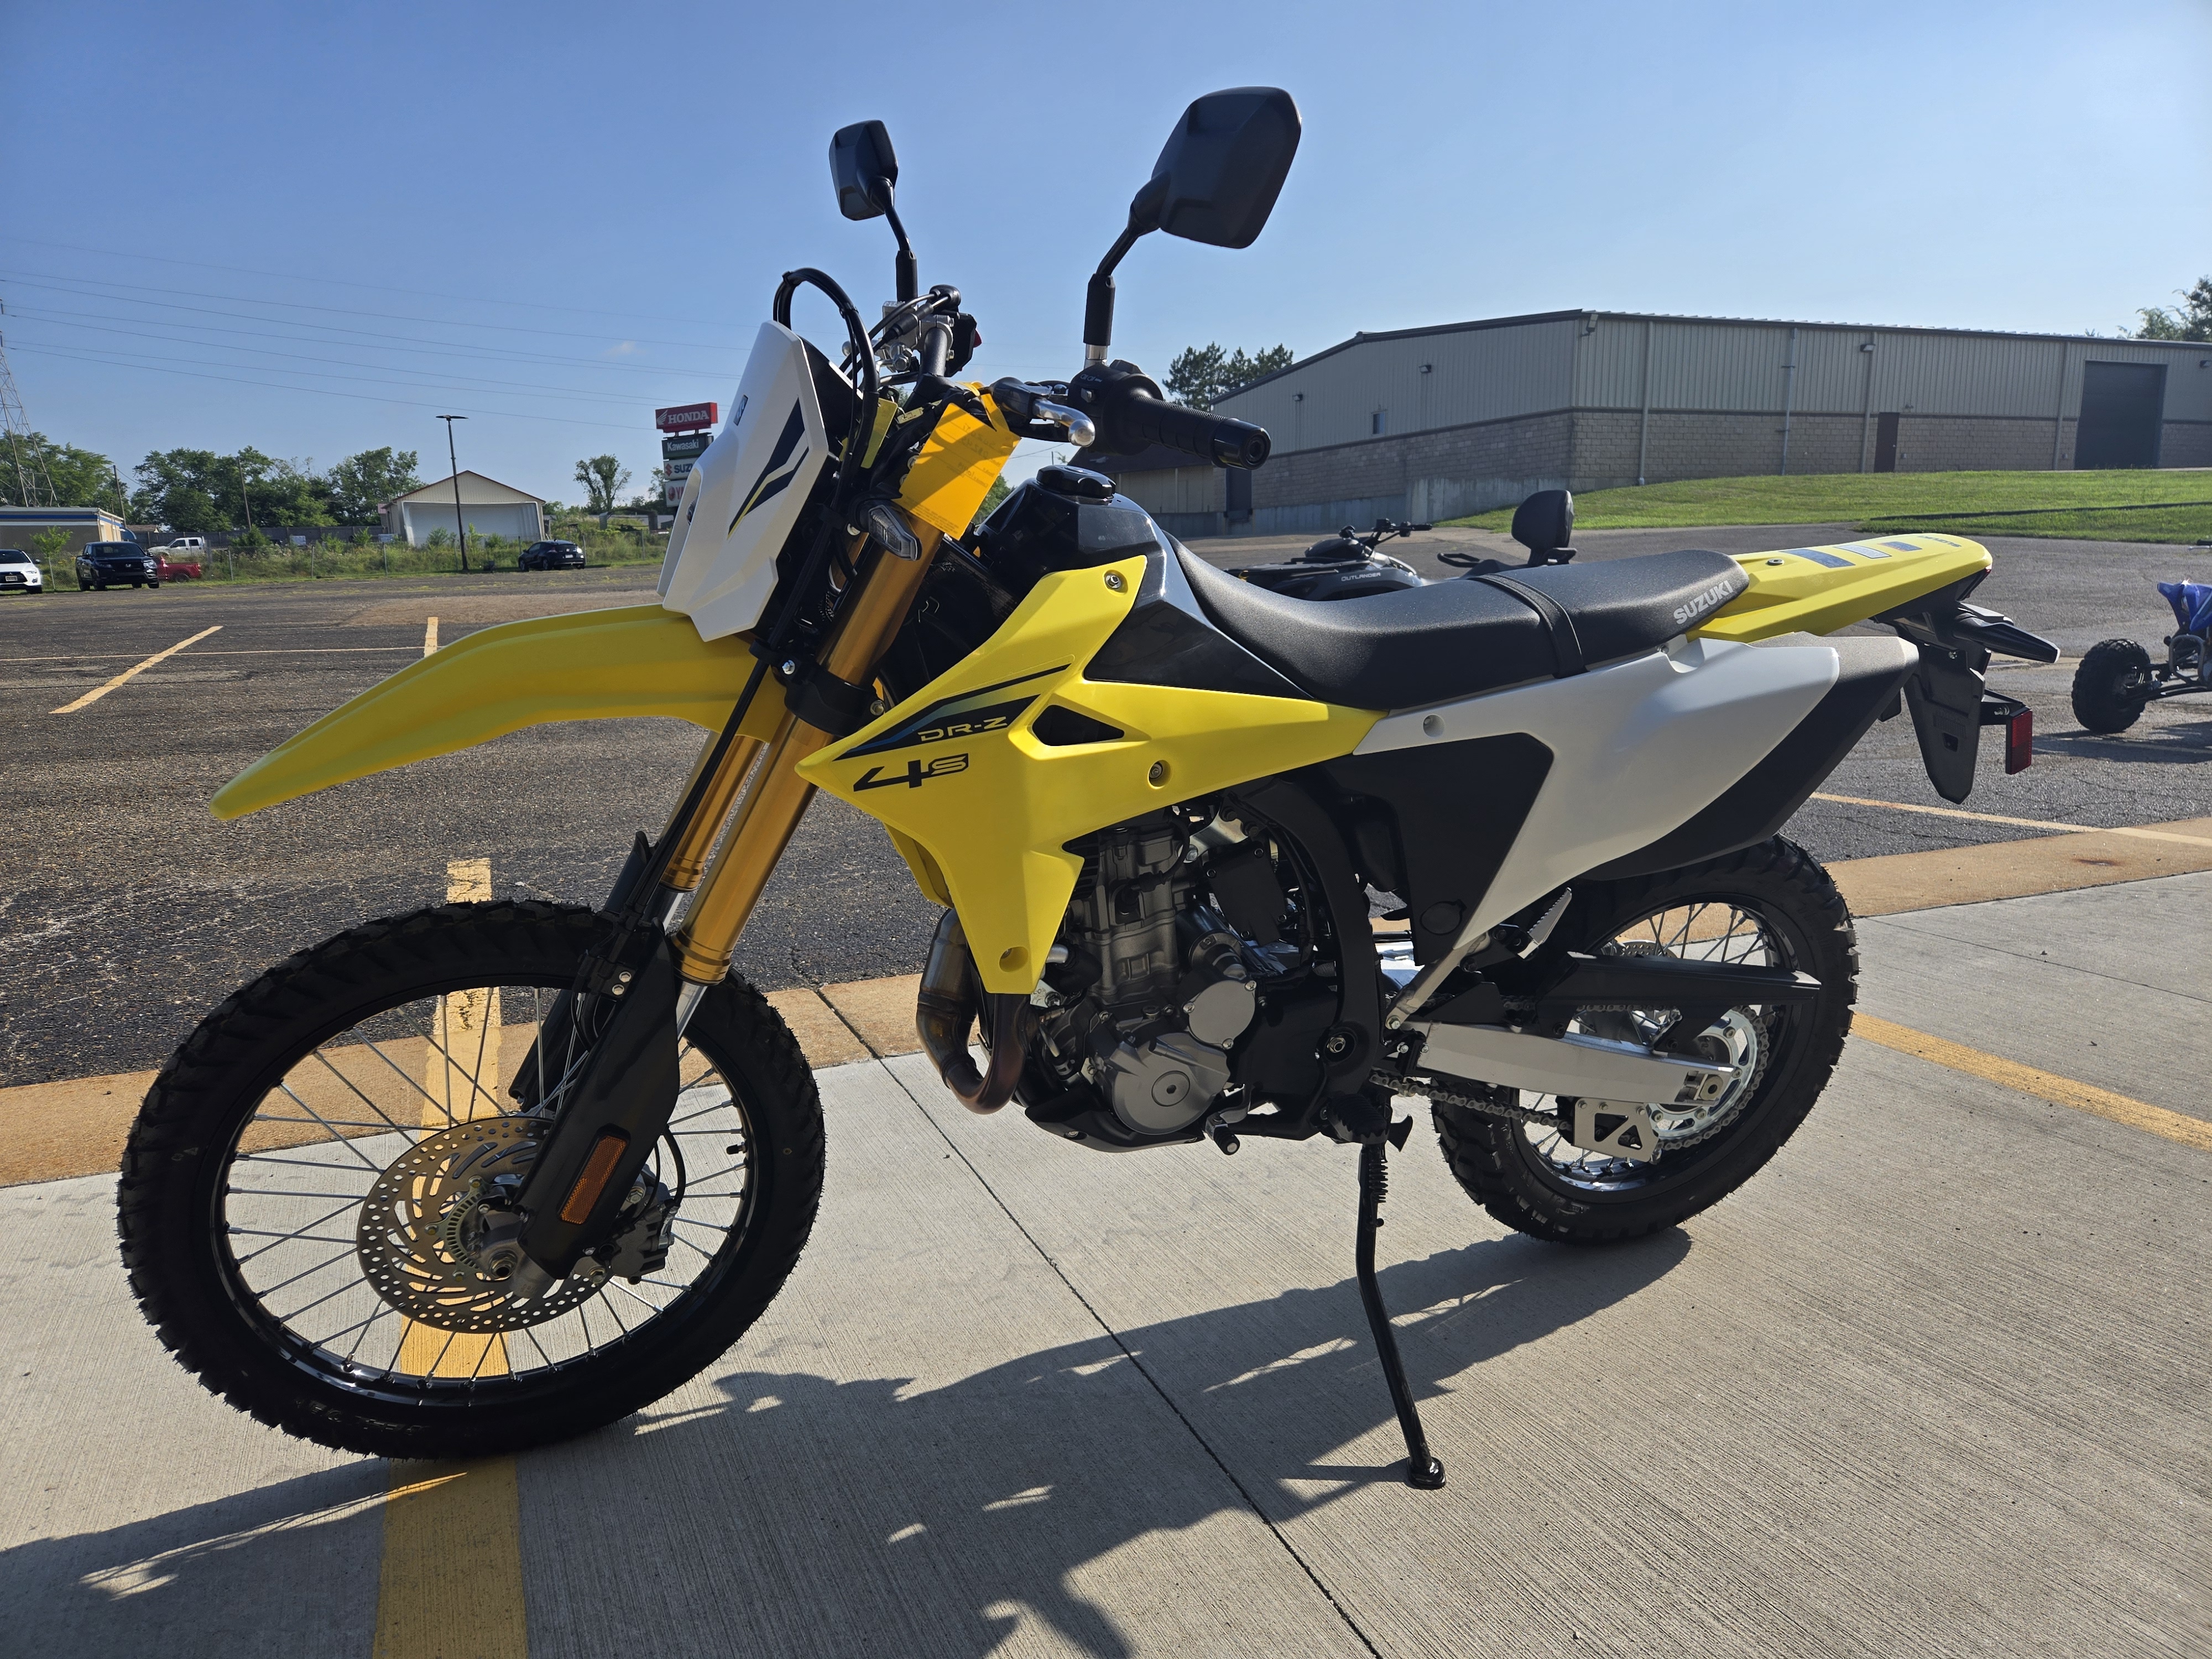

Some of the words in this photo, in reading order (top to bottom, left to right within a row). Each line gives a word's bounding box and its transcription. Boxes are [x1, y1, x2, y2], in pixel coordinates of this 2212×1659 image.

[667, 410, 709, 424] HONDA
[667, 439, 699, 451] Kawasaki
[674, 463, 694, 473] SUZ
[1341, 572, 1381, 581] OUTLANDER
[1673, 580, 1734, 625] SUZUKI
[917, 716, 1008, 742] DR-Z
